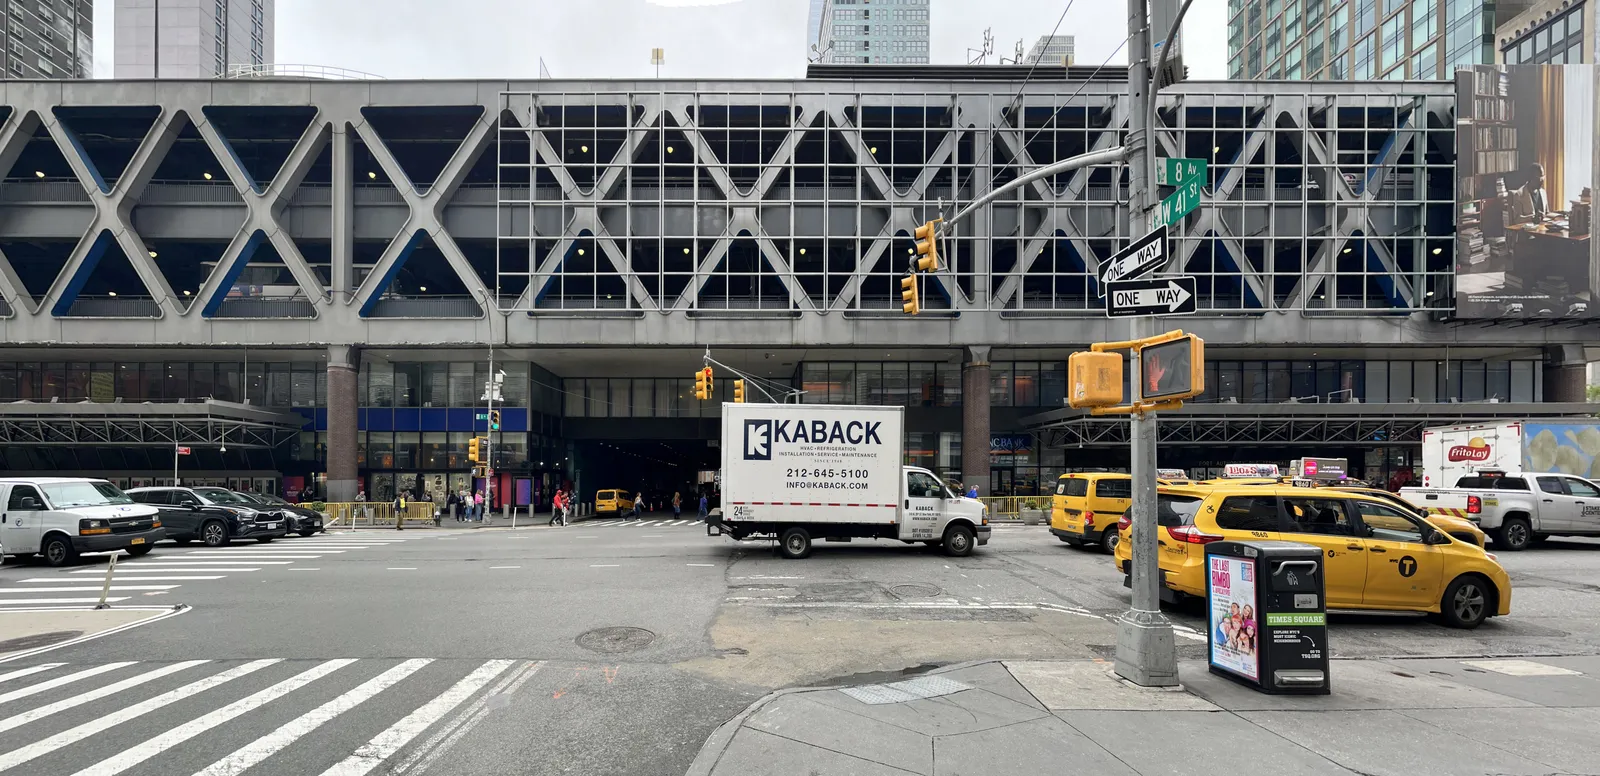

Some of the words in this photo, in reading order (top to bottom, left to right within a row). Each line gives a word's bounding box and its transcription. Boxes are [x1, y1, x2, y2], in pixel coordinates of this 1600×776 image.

[1175, 162, 1183, 182] 8
[1188, 162, 1197, 175] Av
[1162, 200, 1171, 223] W
[1175, 190, 1186, 214] 41
[1190, 182, 1197, 198] St
[1108, 261, 1125, 281] ONE
[1137, 241, 1158, 265] WAY
[1116, 291, 1140, 306] ONE
[1156, 289, 1181, 303] WAY
[774, 420, 882, 444] KABACK
[990, 438, 1000, 447] NC
[1001, 438, 1024, 447] BANK
[786, 469, 869, 478] 212-645-5100
[734, 506, 742, 516] 24
[1401, 559, 1415, 575] T
